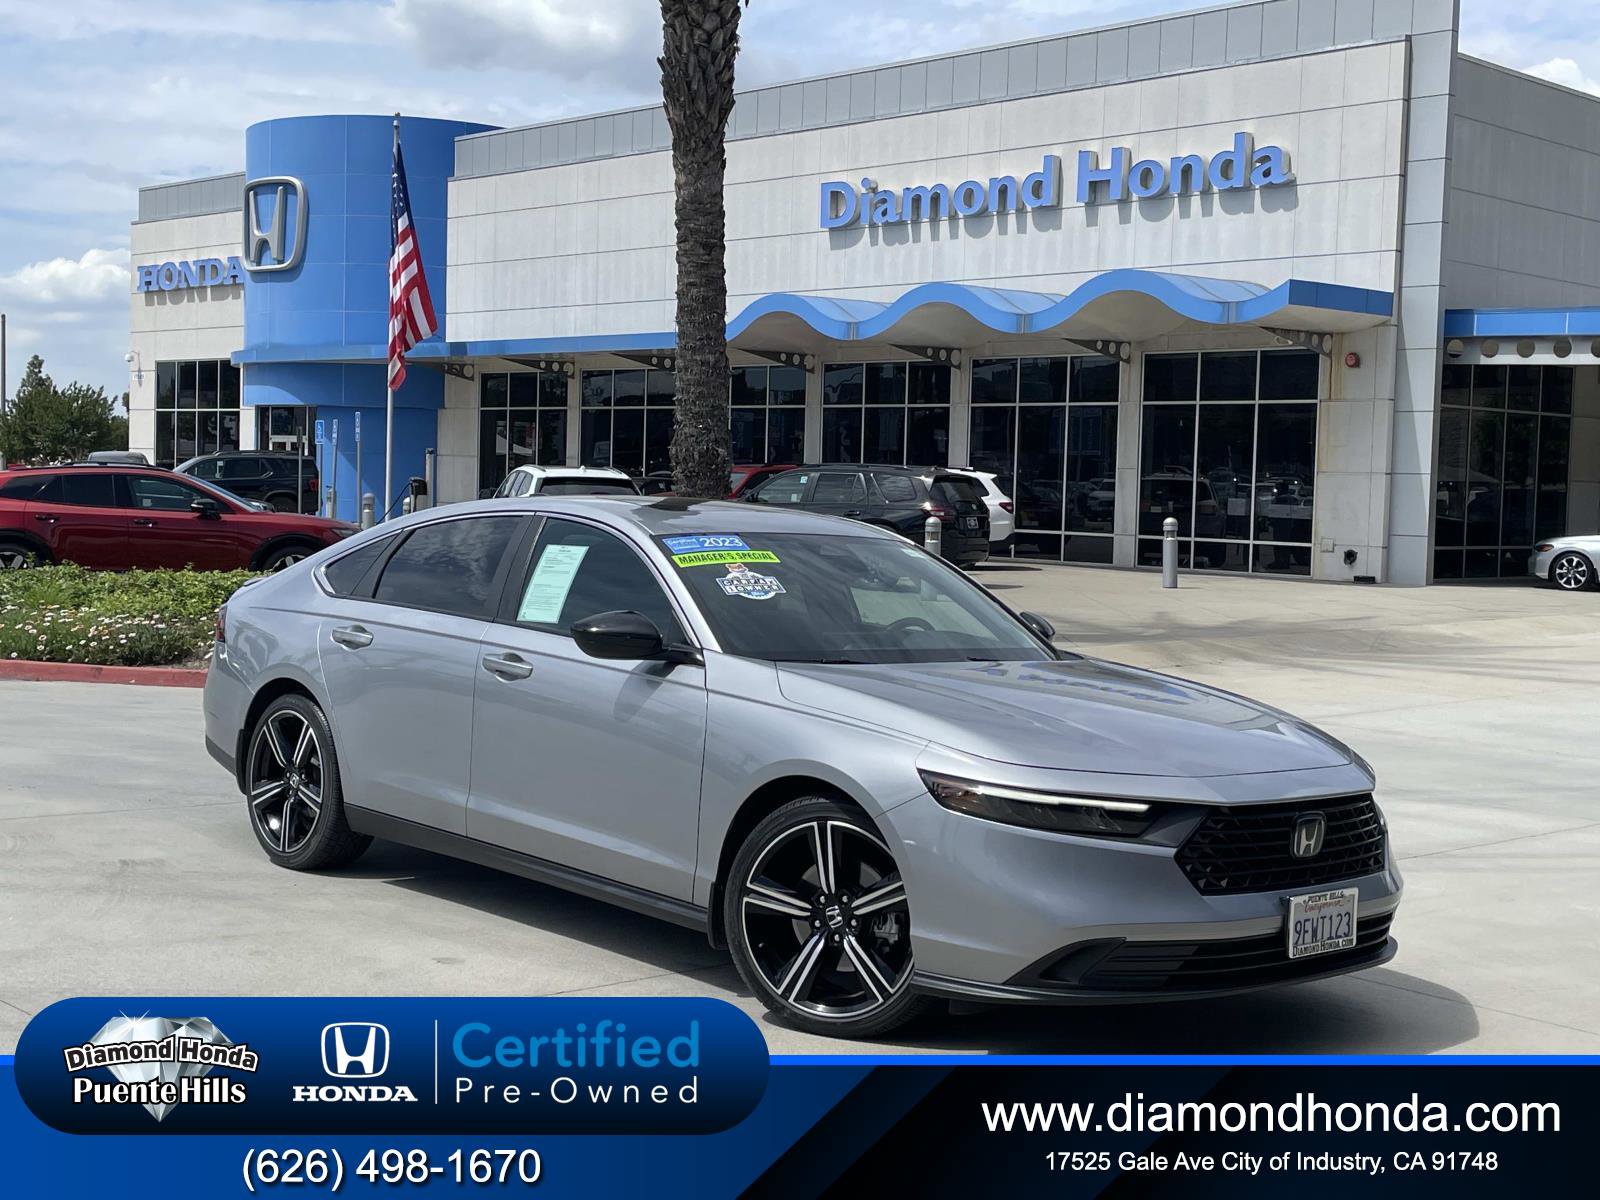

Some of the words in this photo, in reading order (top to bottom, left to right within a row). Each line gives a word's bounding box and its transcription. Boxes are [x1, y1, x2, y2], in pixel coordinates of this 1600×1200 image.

[820, 154, 1061, 231] Diamond
[1076, 131, 1295, 204] Honda
[136, 256, 244, 292] HONDA
[699, 537, 743, 547] 2023
[737, 552, 777, 561] SPECIAL
[1294, 911, 1351, 946] 9FWT123
